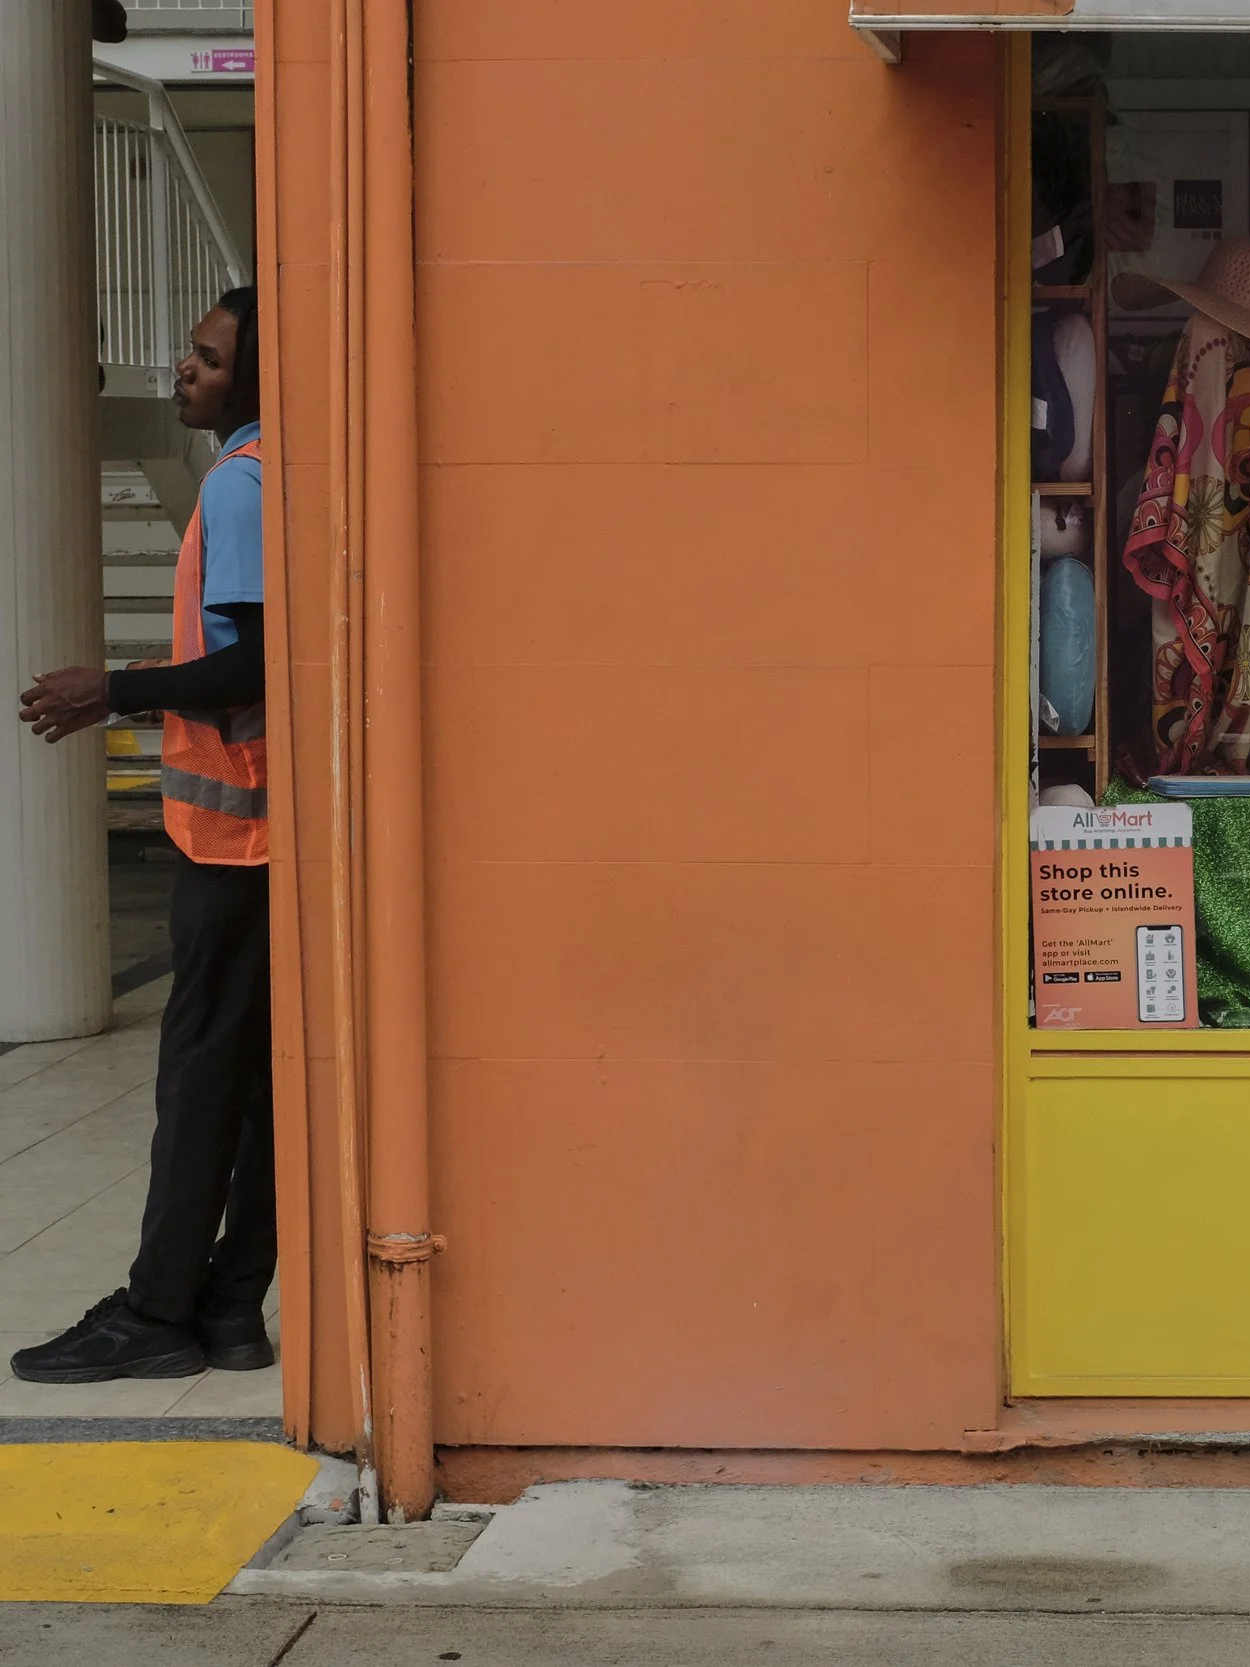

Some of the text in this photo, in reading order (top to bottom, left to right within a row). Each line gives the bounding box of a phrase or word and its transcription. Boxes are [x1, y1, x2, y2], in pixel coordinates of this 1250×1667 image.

[1039, 861, 1140, 882] Shop this
[1040, 883, 1173, 902] store online.
[1041, 907, 1077, 915] Same-Day
[1078, 906, 1104, 914] Pickup
[1153, 904, 1182, 912] Delivery
[1041, 940, 1057, 948] Get
[1059, 939, 1074, 947] the
[1042, 950, 1059, 958] app
[1072, 949, 1091, 957] visit
[1042, 958, 1119, 967] allmartplace.com
